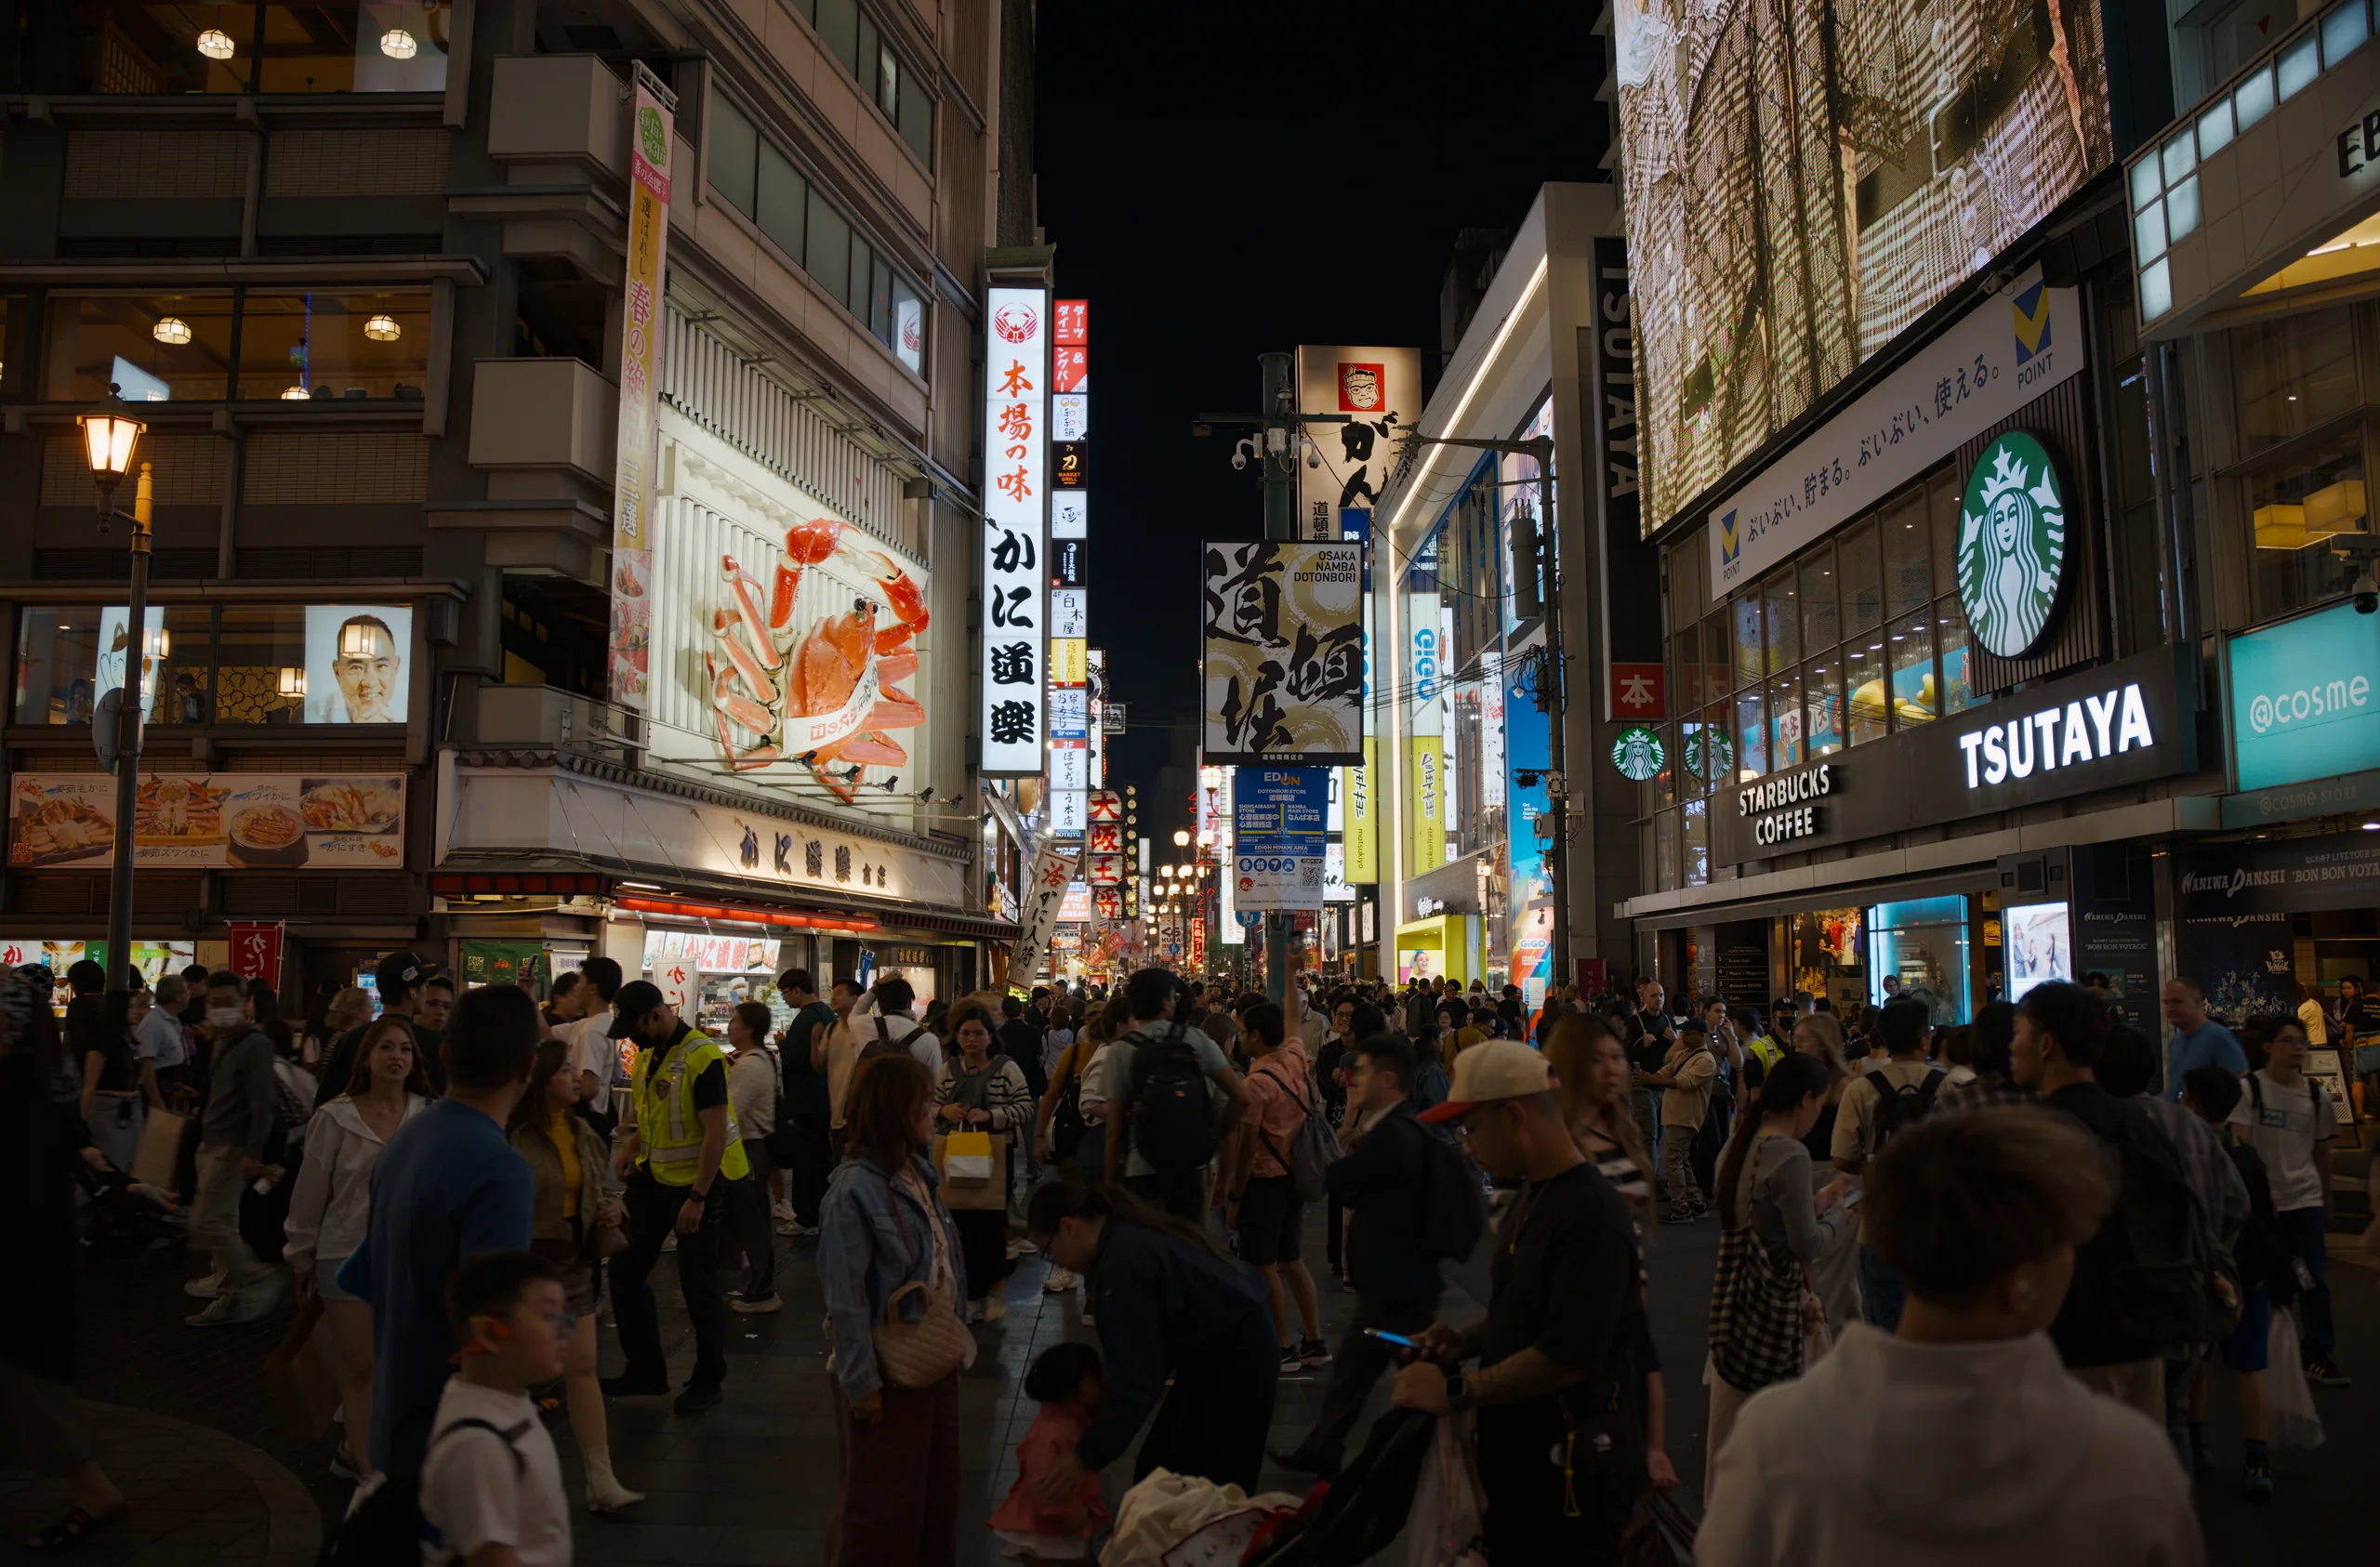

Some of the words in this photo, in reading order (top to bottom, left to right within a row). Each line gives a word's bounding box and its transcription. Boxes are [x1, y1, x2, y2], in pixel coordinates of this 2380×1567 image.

[639, 194, 654, 276] 選ばれし
[1057, 305, 1070, 392] ダイニングバー
[2016, 352, 2054, 390] POINT
[996, 359, 1035, 504] 本場の味
[1747, 456, 1852, 544] ぶいぶい、貯まる。
[1858, 353, 2000, 468] ぶいぶい、使える。
[1316, 561, 1356, 573] NAMBA
[1318, 550, 1356, 561] OSAKA
[1293, 572, 1356, 583] DOTONBORI
[1723, 563, 1741, 583] POINT
[1063, 593, 1084, 634] 白木屋
[1620, 674, 1655, 709] 本
[2250, 675, 2370, 733] @cosme
[1063, 741, 1075, 749] 2F
[1960, 683, 2153, 789] TSUTAYA
[1263, 771, 1301, 786] EDION
[1352, 757, 1368, 819] ツモトキヨシ
[1739, 764, 1830, 817] STARBUCKS
[2260, 792, 2316, 815] @cosme
[2320, 785, 2358, 803] STORE
[1755, 807, 1814, 846] COFFEE
[326, 842, 366, 852] かにすき
[2332, 851, 2349, 862] LIVE
[2349, 849, 2370, 860] TOUR
[2182, 871, 2228, 896] NANIWA
[2227, 868, 2286, 899] DANSHI
[2320, 865, 2346, 880] BON
[1161, 927, 1182, 938] くら
[1520, 940, 1546, 948] GiGO
